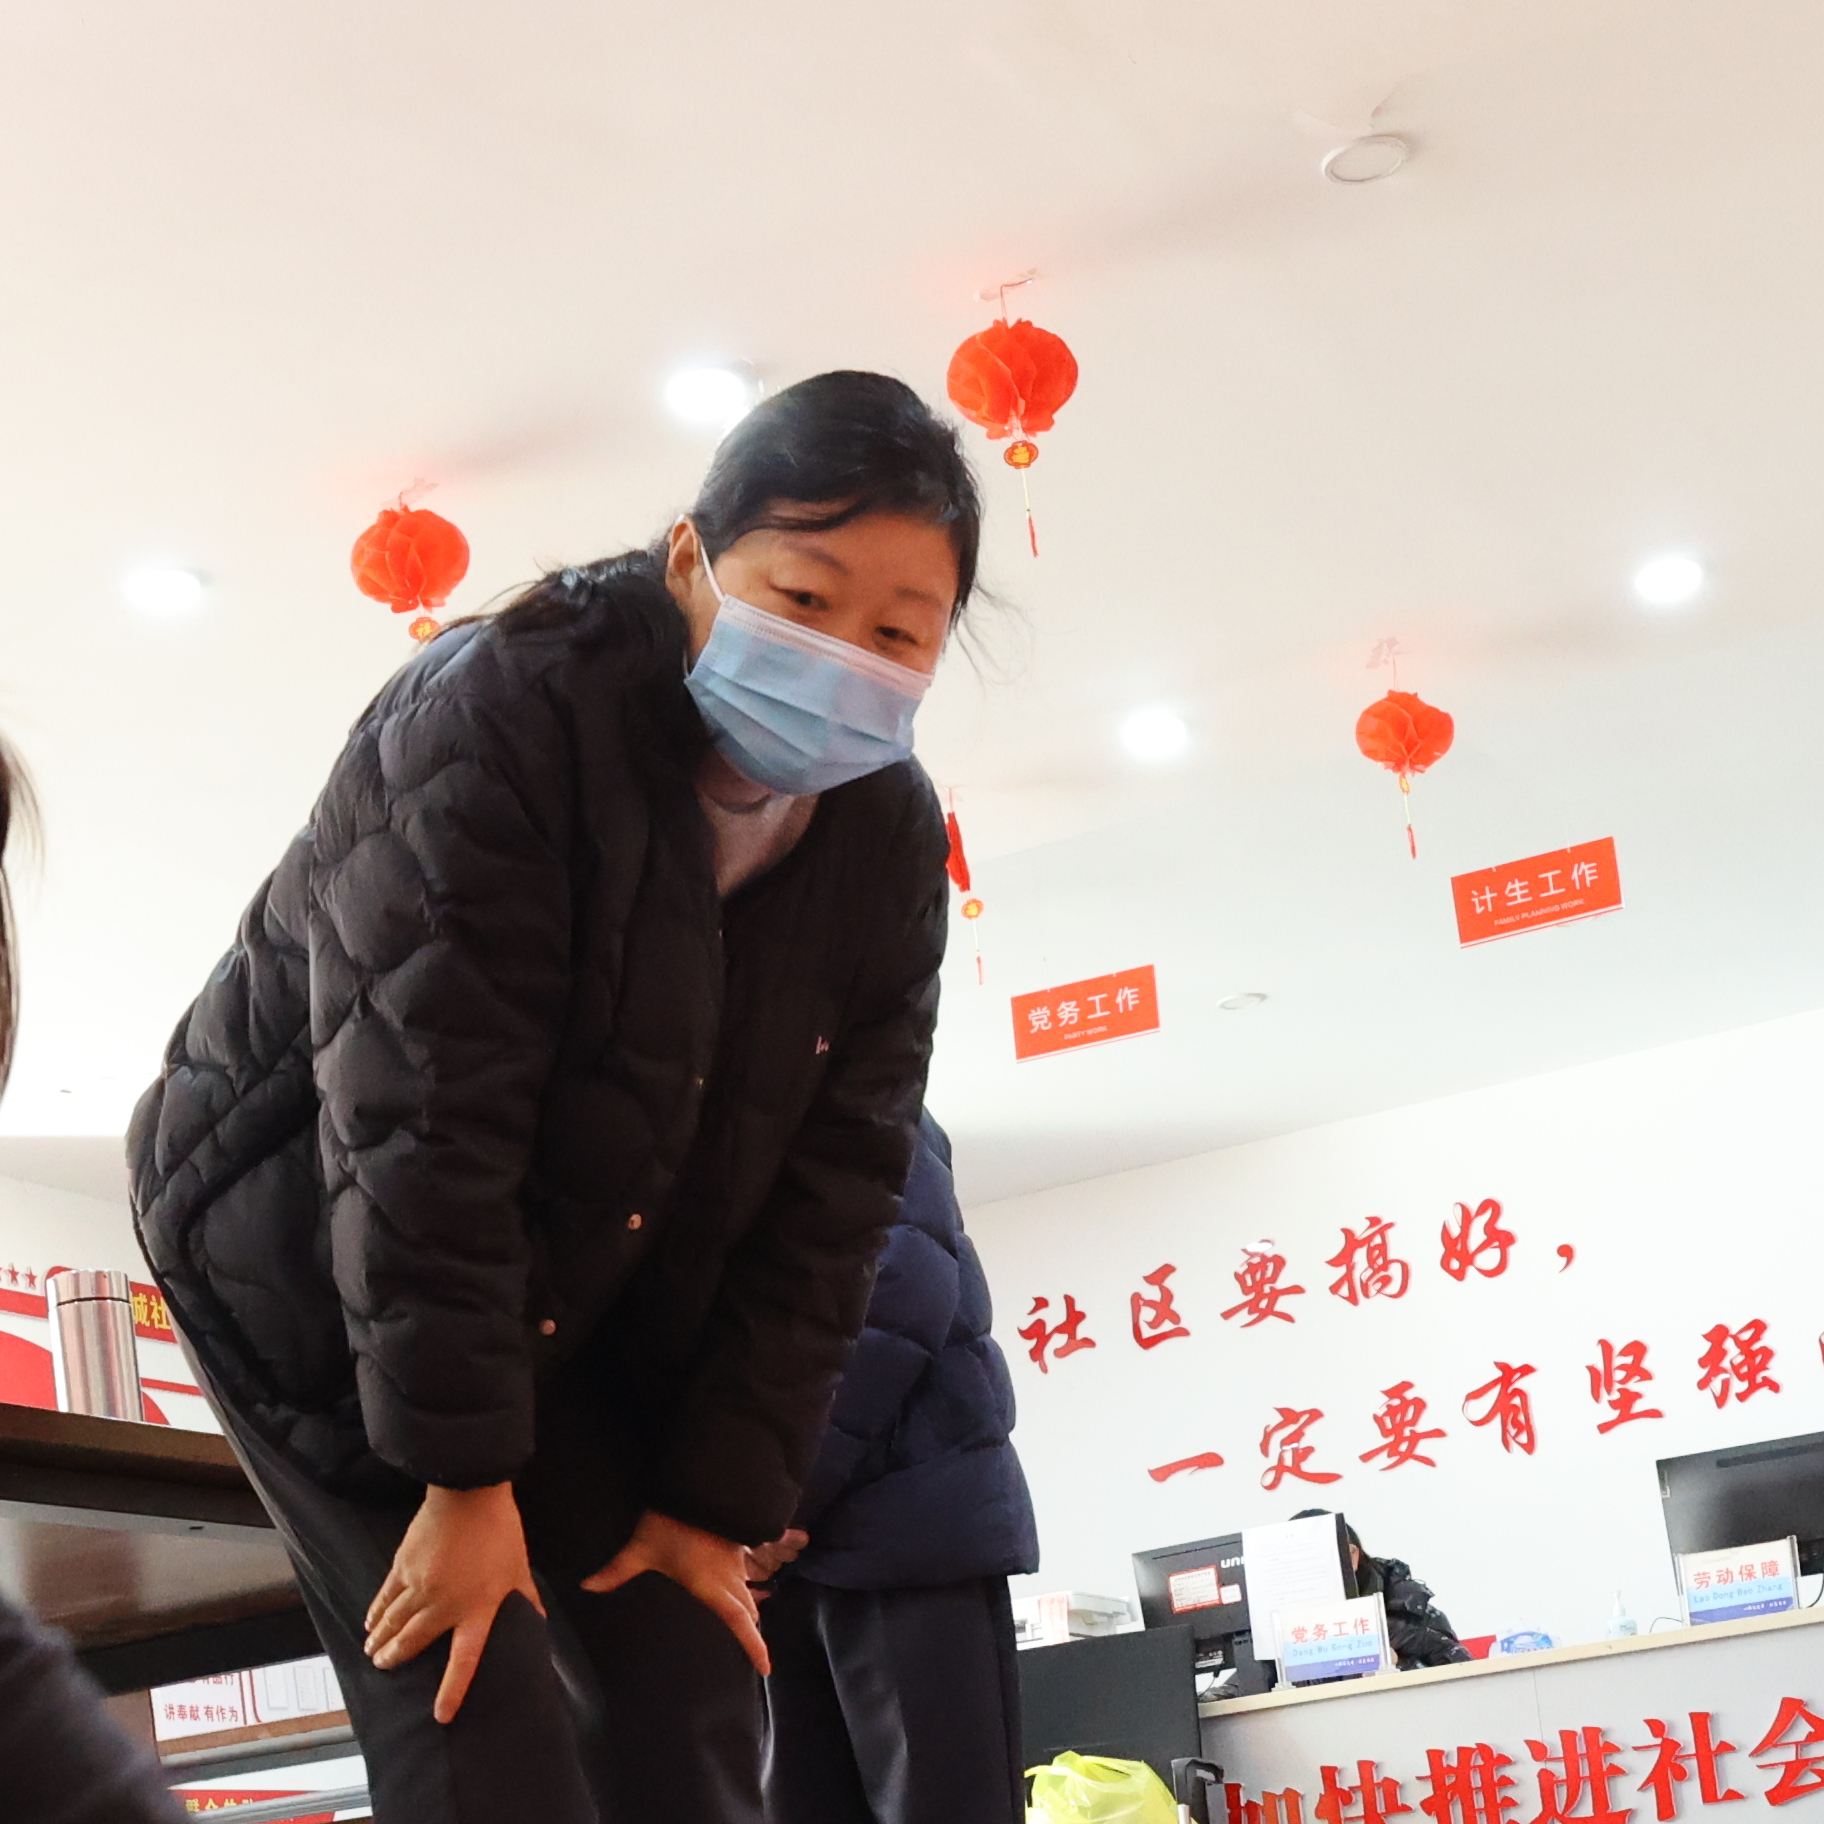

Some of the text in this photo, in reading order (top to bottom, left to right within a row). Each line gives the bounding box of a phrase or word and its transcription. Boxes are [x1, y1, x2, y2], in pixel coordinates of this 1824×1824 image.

[1471, 861, 1599, 915] 计生工作
[1494, 899, 1585, 926] FAMILY PLANNING WORK
[1028, 986, 1140, 1034] 党务工作
[1064, 1025, 1108, 1040] PARTY WORK
[1694, 1560, 1780, 1590] 劳动保障
[1694, 1595, 1710, 1603] Lao
[1757, 1583, 1784, 1594] Zhang
[1291, 1617, 1371, 1644] 党务工作
[163, 1704, 239, 1723] 讲奉献 有作为
